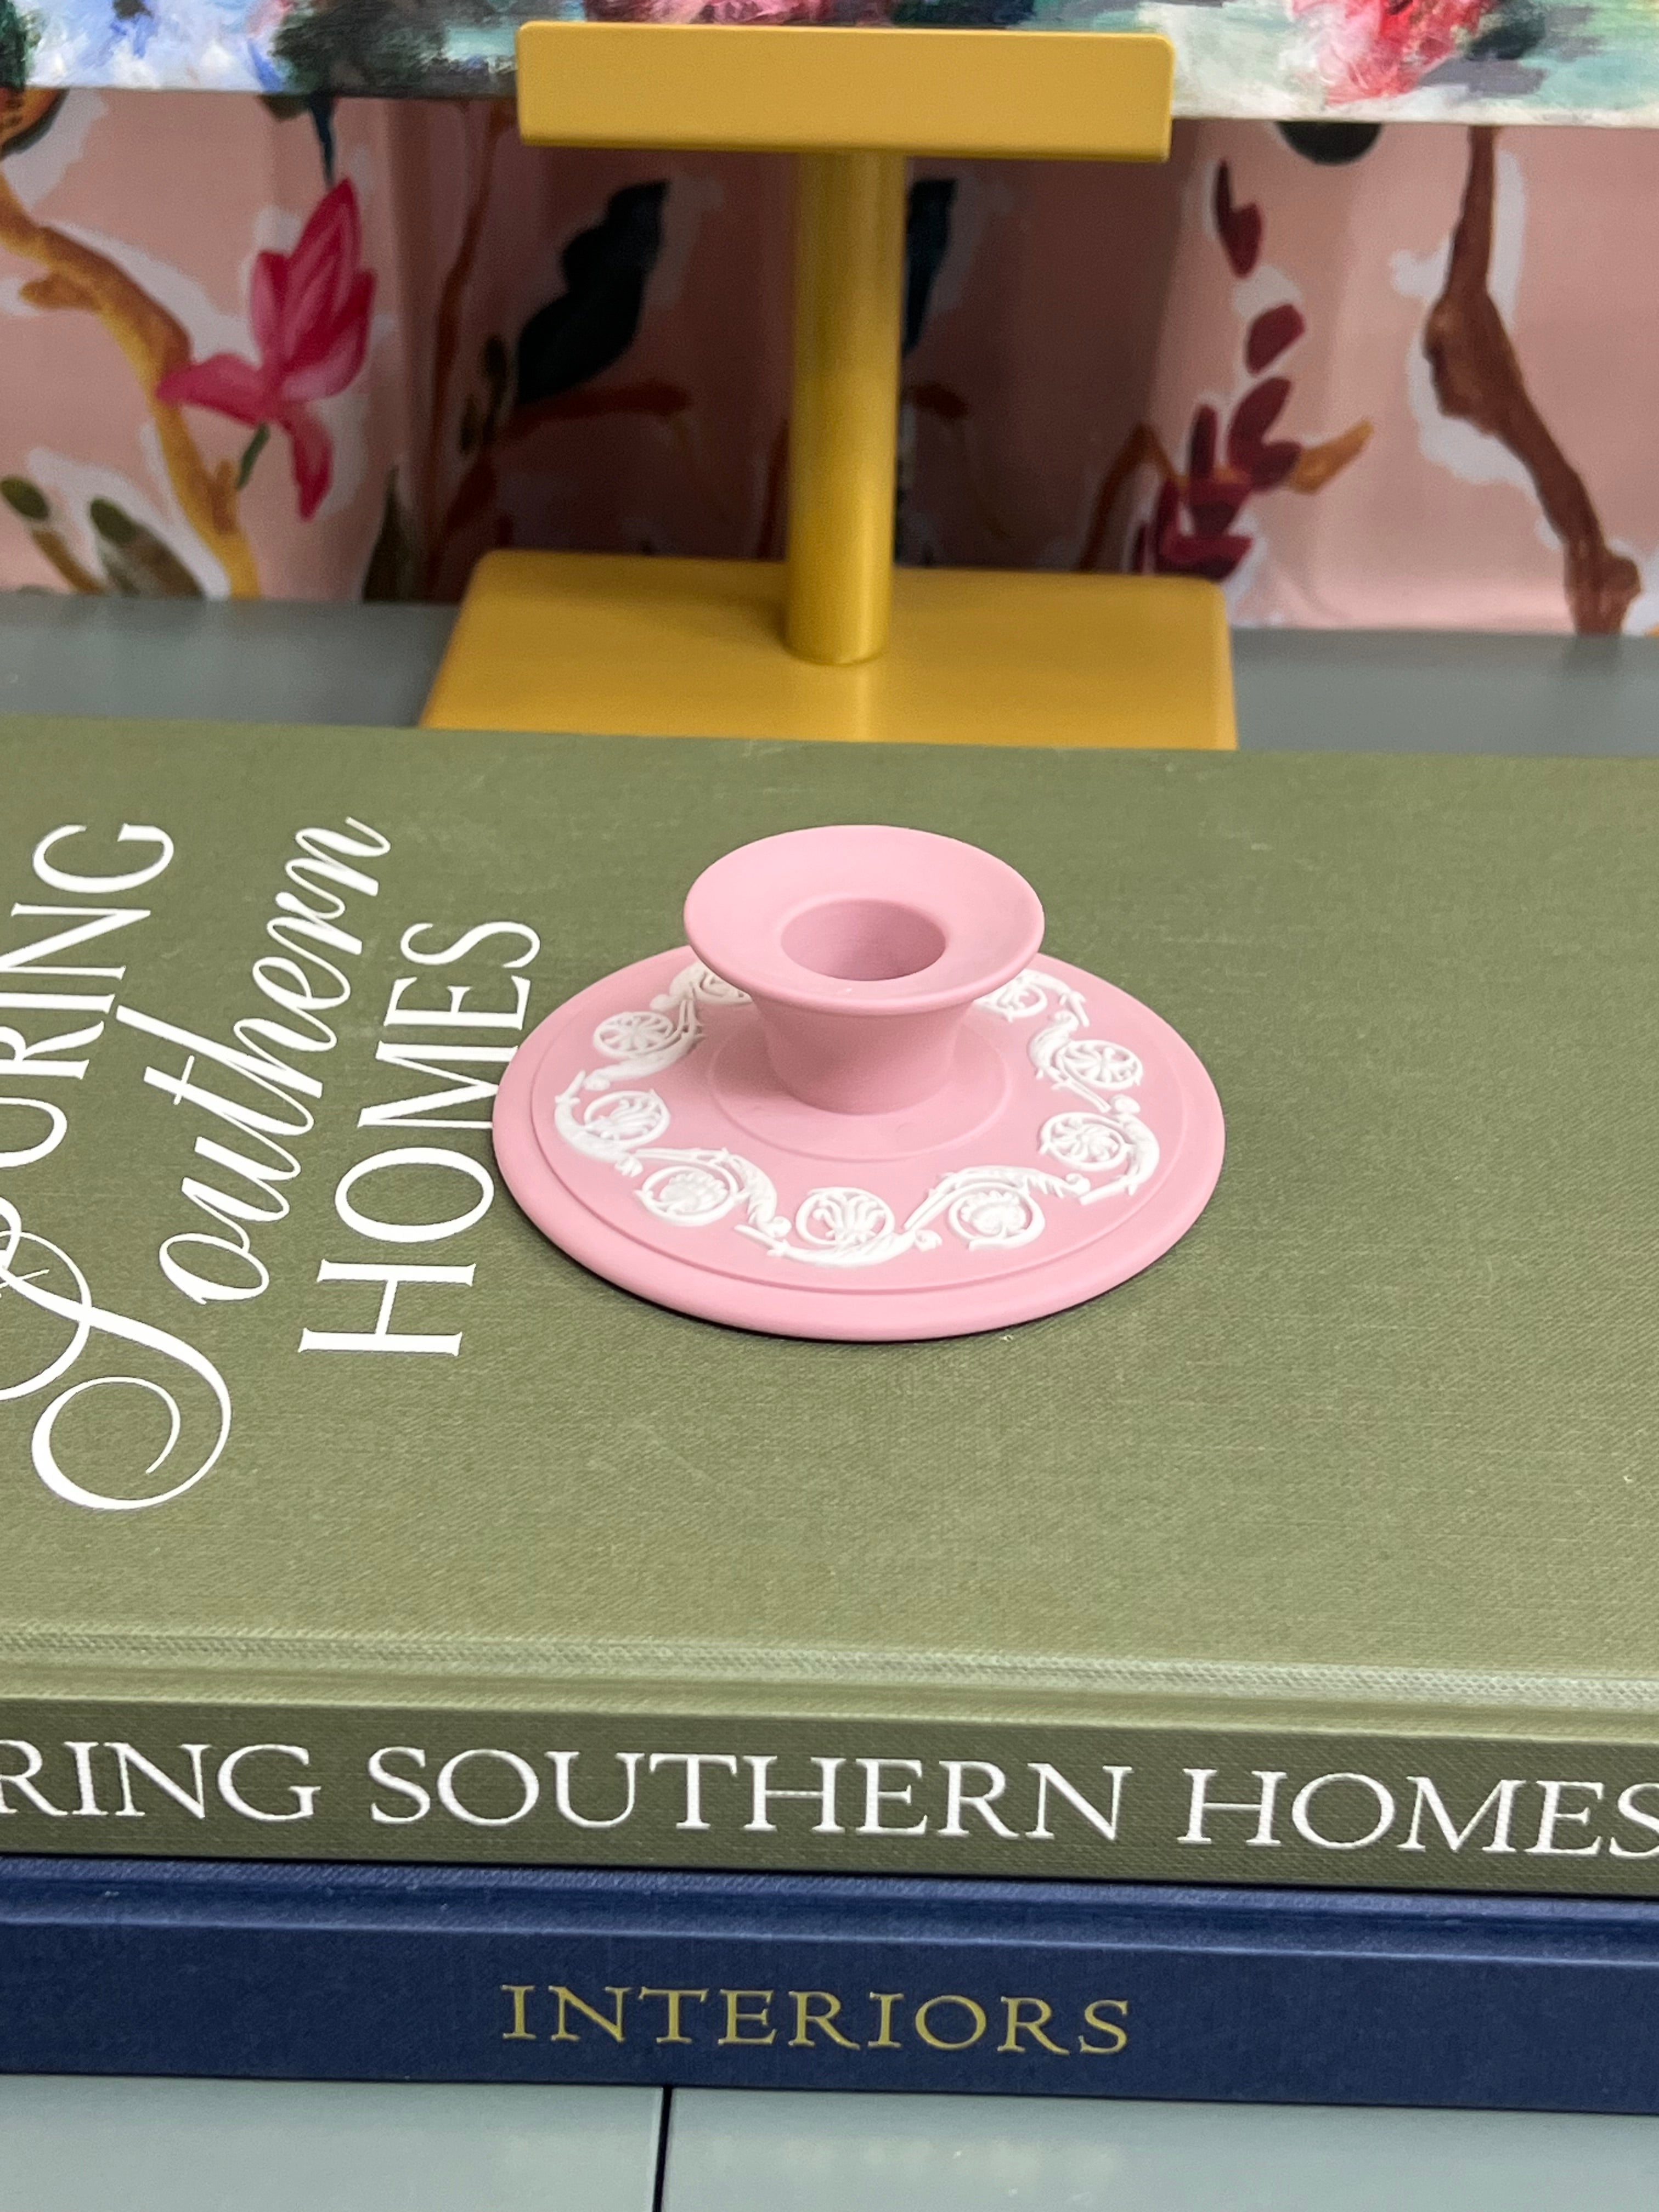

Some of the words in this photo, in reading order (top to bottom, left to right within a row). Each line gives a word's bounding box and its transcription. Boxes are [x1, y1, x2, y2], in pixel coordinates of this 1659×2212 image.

[0, 816, 391, 1512] Southern
[297, 921, 541, 1357] HOMES
[0, 1739, 321, 1821] RING
[368, 1746, 1133, 1841] SOUTHERN
[1176, 1768, 1659, 1859] HOMES
[501, 1984, 1129, 2055] INTERIORS
